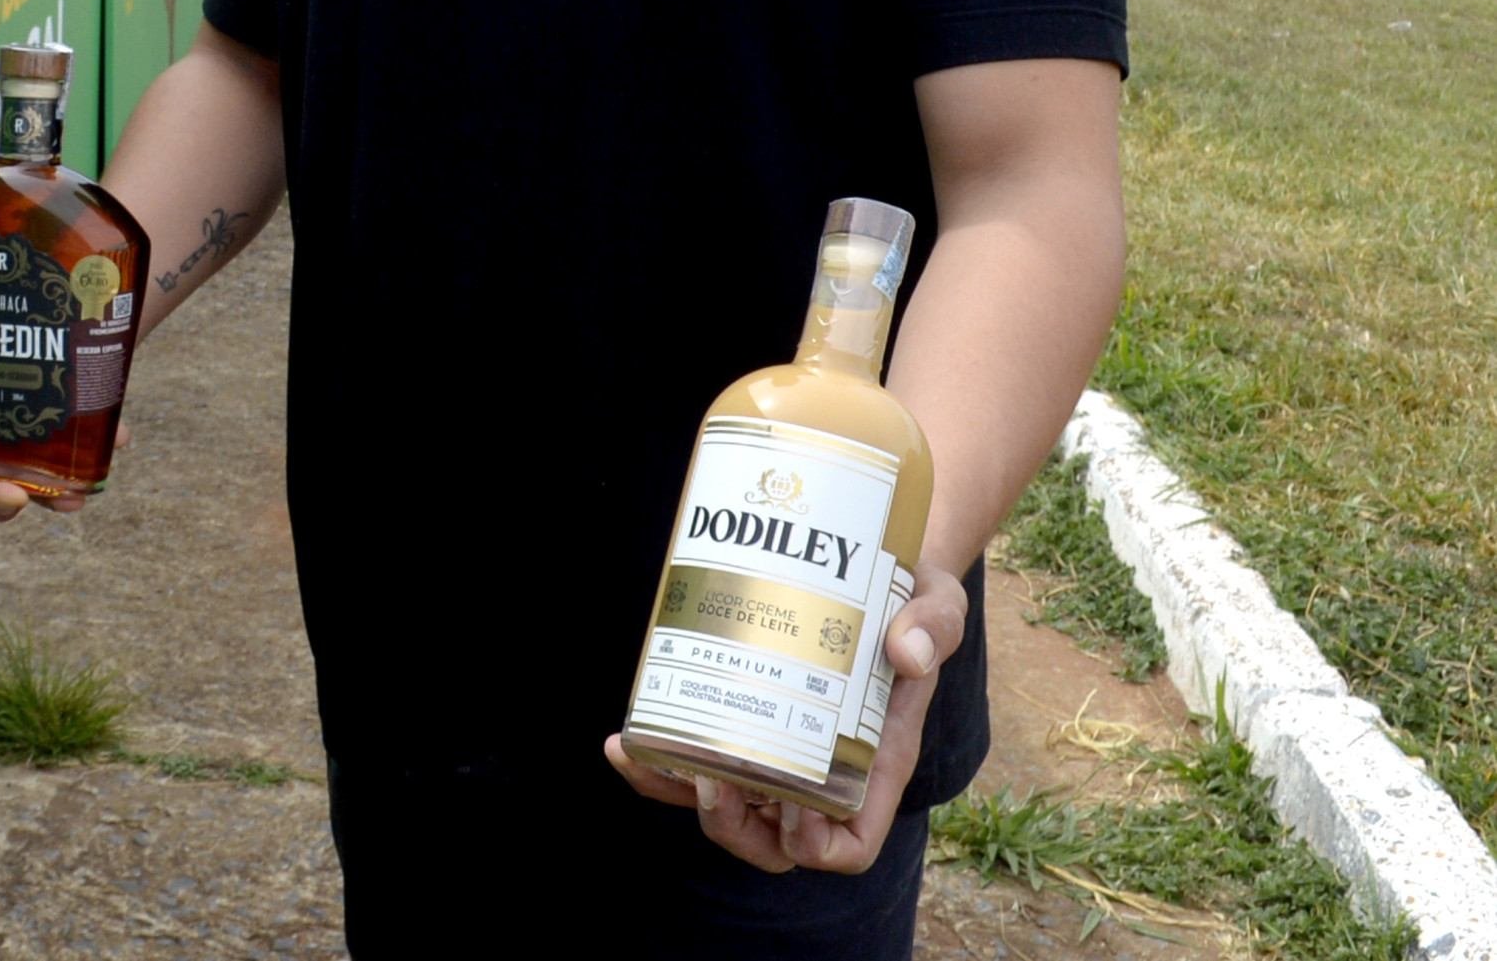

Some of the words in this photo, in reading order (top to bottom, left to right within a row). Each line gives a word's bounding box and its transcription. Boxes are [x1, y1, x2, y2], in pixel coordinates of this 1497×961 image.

[14, 117, 25, 134] R
[688, 506, 862, 582] DODILEY
[697, 602, 732, 619] DOCE
[736, 610, 756, 625] DE
[760, 616, 800, 638] LEITE
[705, 591, 744, 608] LICOR
[746, 599, 797, 622] CREME
[691, 647, 783, 680] PREMIUM
